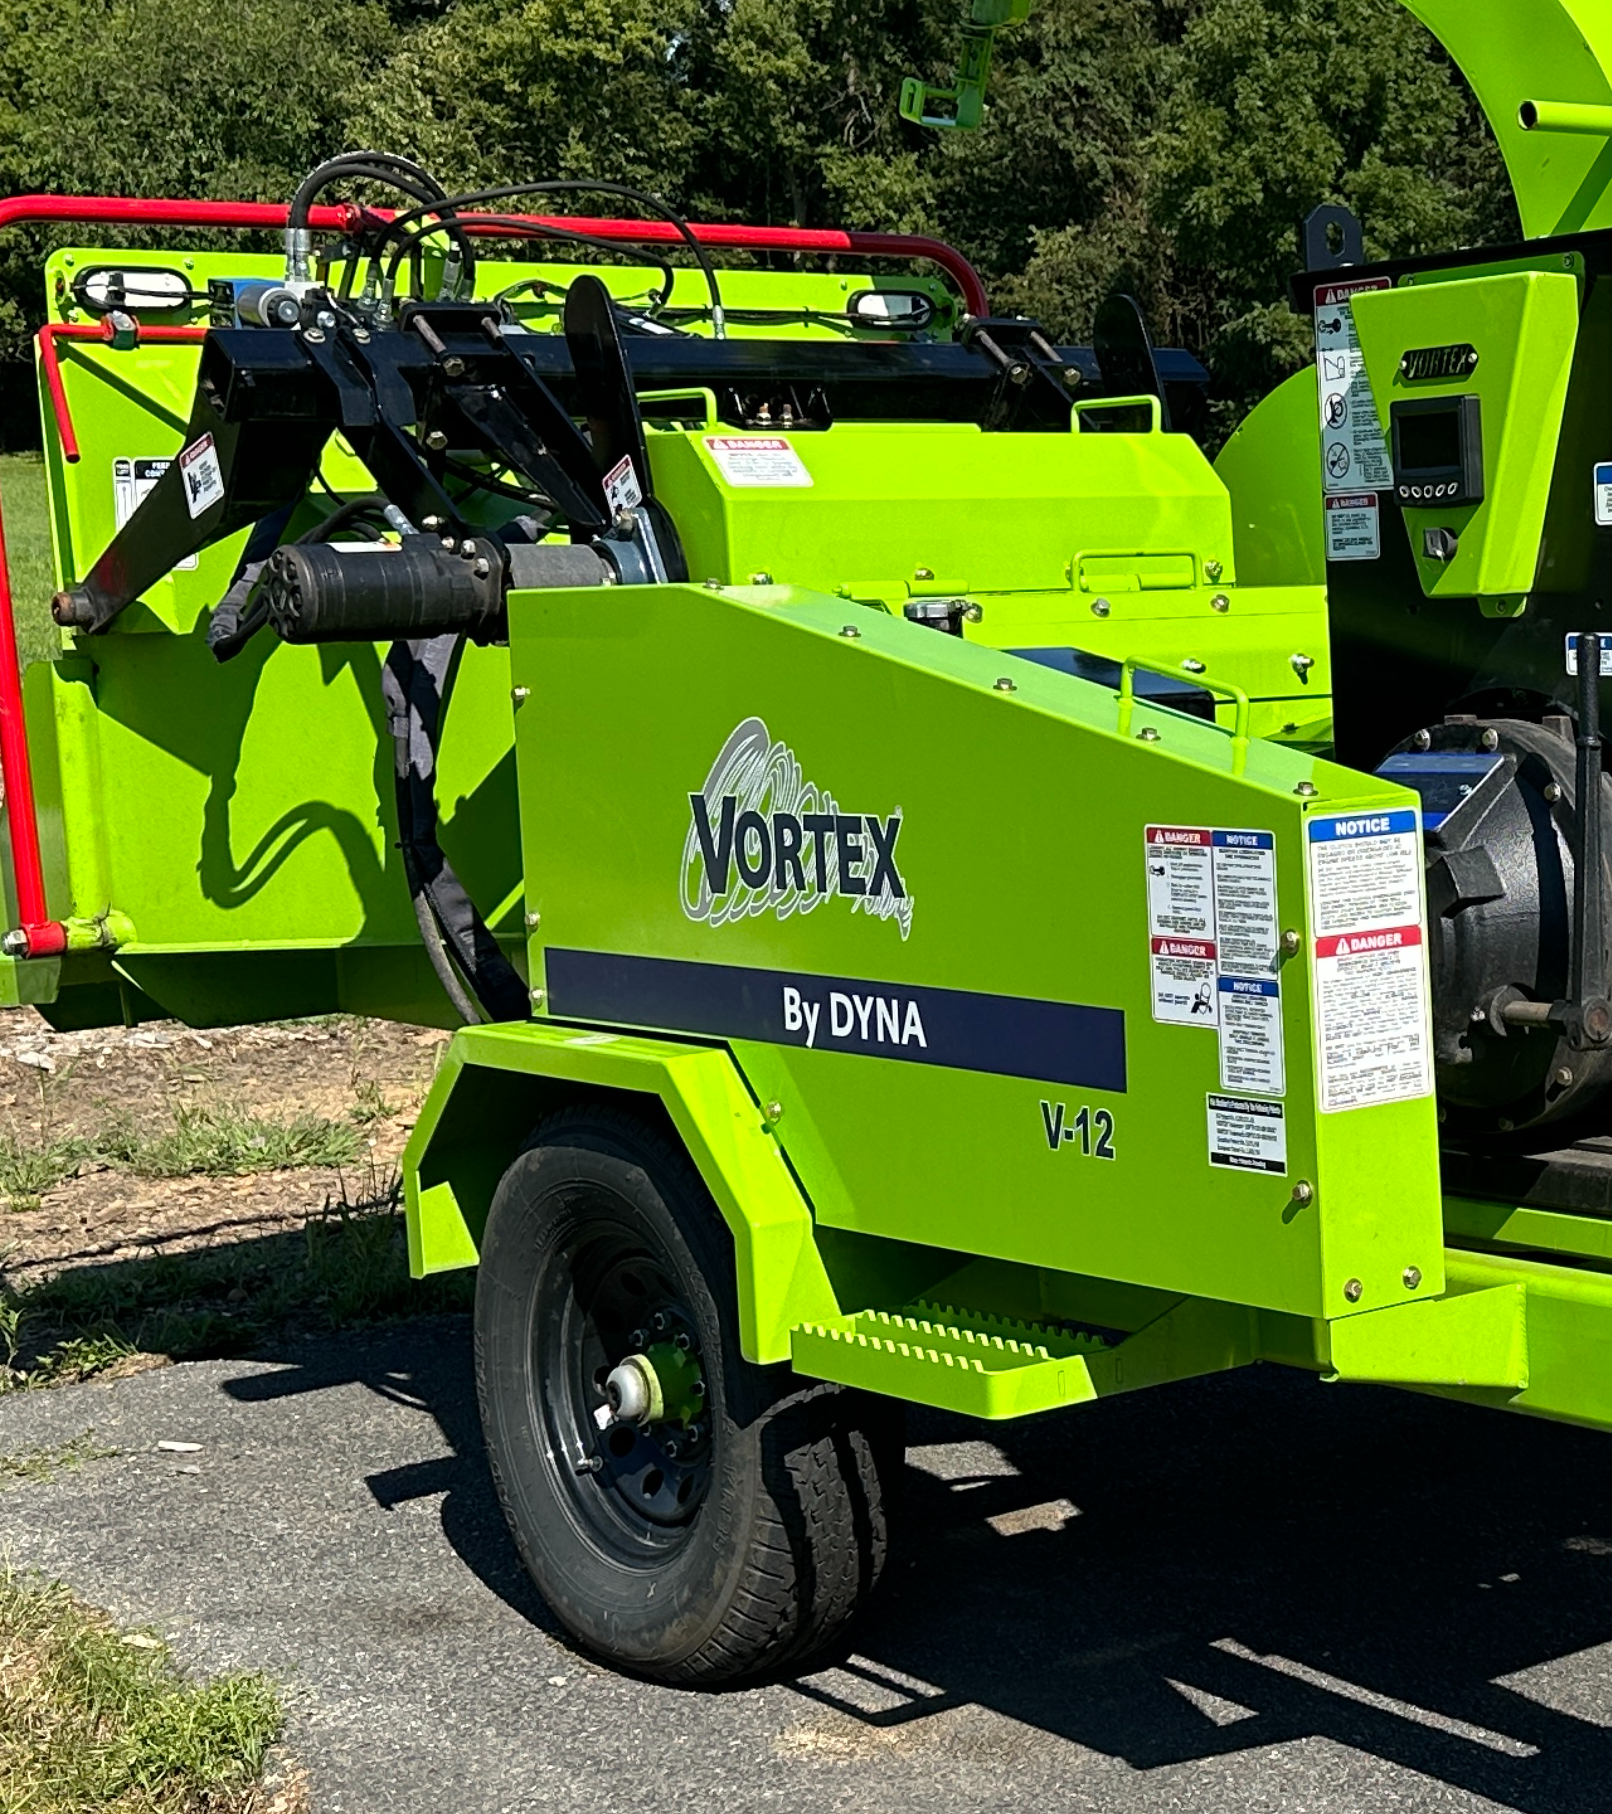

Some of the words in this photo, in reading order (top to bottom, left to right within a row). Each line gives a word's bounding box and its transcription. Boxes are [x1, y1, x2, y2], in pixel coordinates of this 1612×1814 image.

[1408, 348, 1470, 379] VORTEX
[726, 440, 783, 450] DANGER
[1335, 817, 1391, 836] NOTICE
[688, 792, 906, 899] VORTEX
[1164, 832, 1201, 844] DANGER
[1226, 834, 1258, 846] NOTICE
[1170, 943, 1206, 957] DANGER
[1351, 932, 1403, 951] DANGER
[1233, 981, 1262, 993] NOTICE
[783, 986, 821, 1048] By
[829, 992, 928, 1048] DYNA
[1040, 1100, 1116, 1162] V-12
